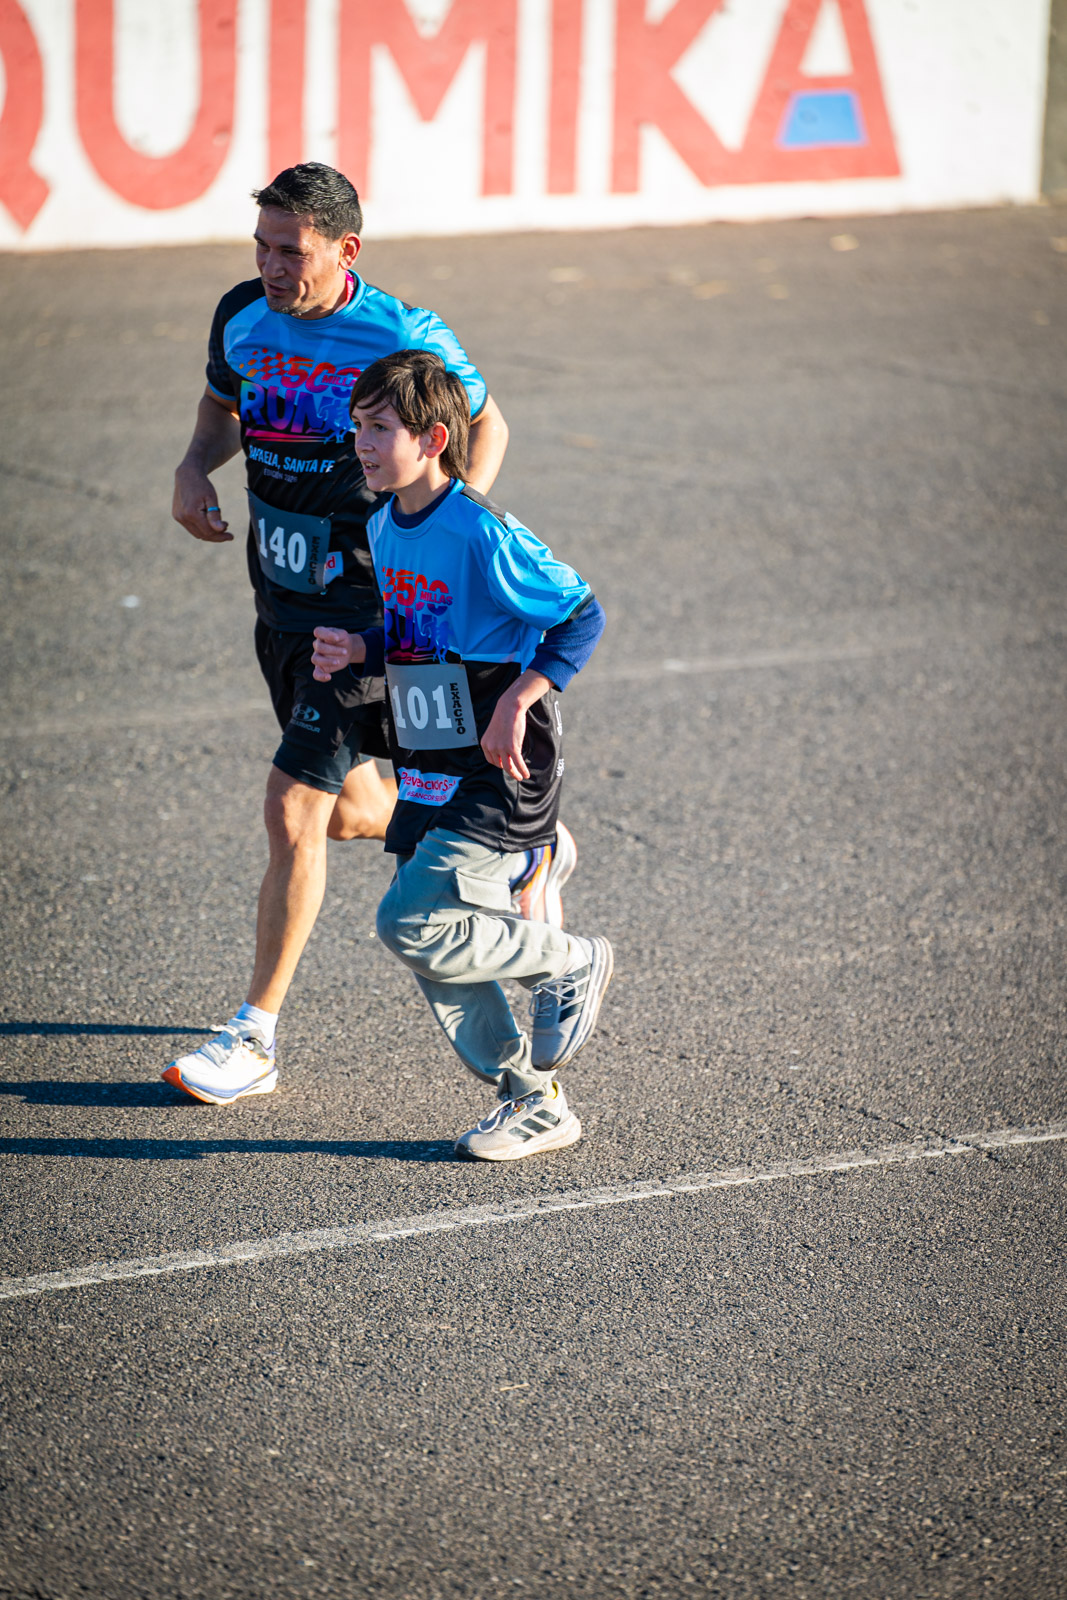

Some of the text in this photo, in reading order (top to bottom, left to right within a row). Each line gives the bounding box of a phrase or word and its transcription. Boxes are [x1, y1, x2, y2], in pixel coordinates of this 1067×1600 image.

[0, 0, 902, 231] UIMIKA
[321, 375, 357, 387] MILL
[283, 456, 318, 473] SANTA
[320, 460, 336, 474] FE
[258, 517, 307, 574] 140
[308, 535, 321, 585] EXACTO
[395, 569, 449, 617] 500
[419, 590, 454, 606] MILLAS
[391, 684, 453, 730] 101
[449, 682, 466, 735] EXACTO
